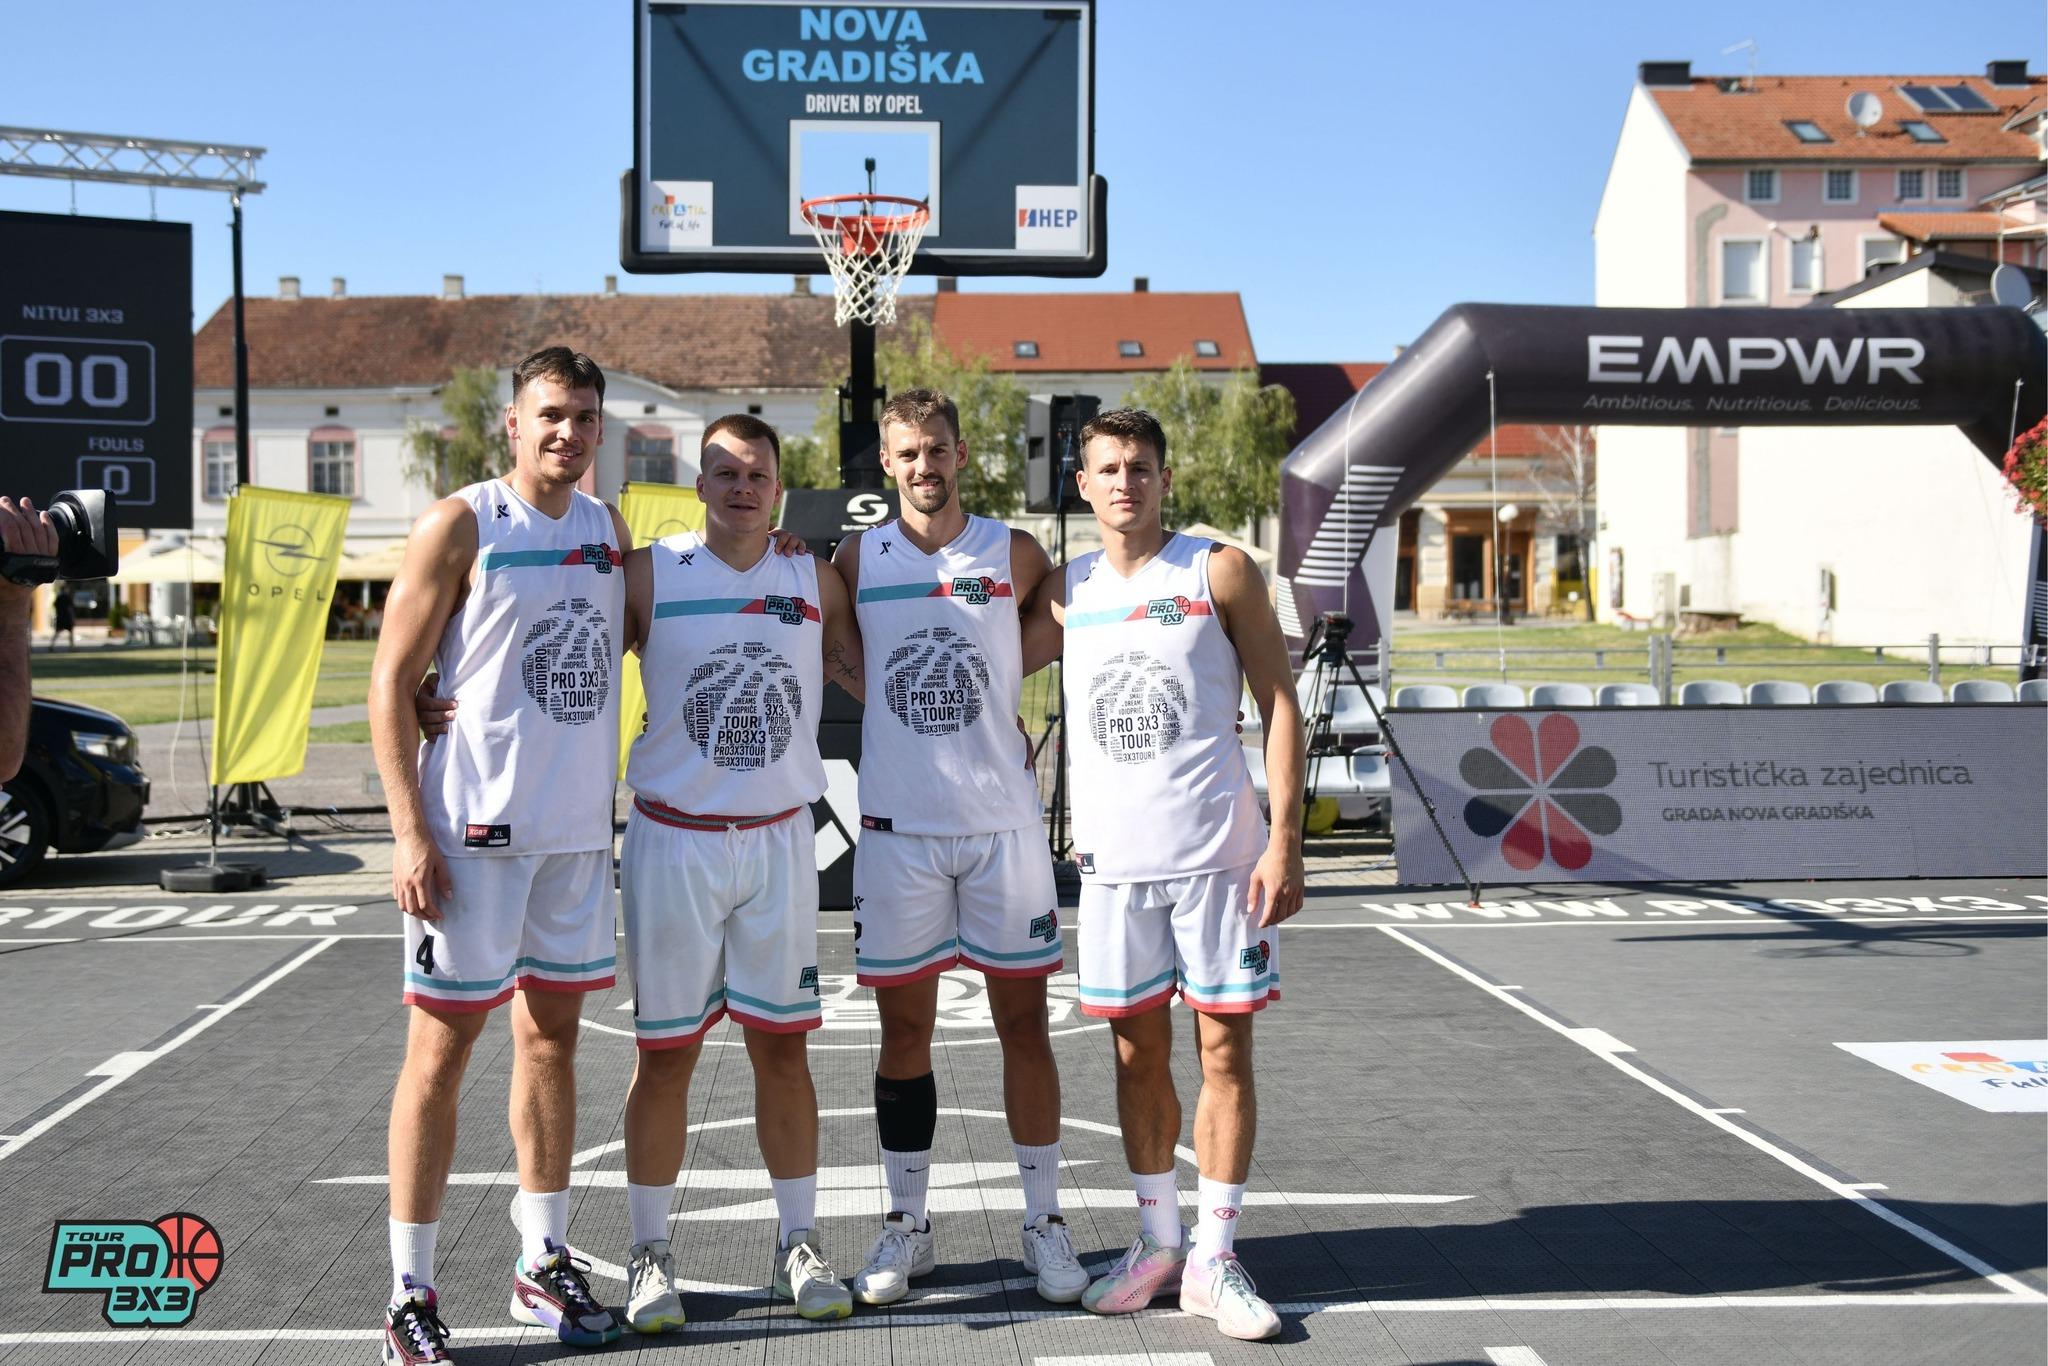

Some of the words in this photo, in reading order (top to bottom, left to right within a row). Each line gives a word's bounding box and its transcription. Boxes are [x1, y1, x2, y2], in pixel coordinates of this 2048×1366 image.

[800, 9, 927, 42] NOVA
[742, 43, 984, 84] GRADIŠKA
[805, 94, 860, 113] DRIVEN
[864, 95, 882, 114] BY
[886, 95, 923, 114] OPEL
[1038, 209, 1077, 228] HEP
[22, 305, 80, 322] NITUI
[85, 307, 124, 324] 3X3
[1587, 335, 1925, 385] EMPWR
[24, 352, 128, 408] 00
[1584, 394, 1694, 411] Ambitious.
[1706, 396, 1813, 412] Nutritious.
[1824, 395, 1921, 412] Delicious.
[89, 437, 144, 452] FOULS
[104, 465, 130, 495] 0
[585, 551, 603, 560] PRO
[248, 583, 326, 601] OPEL
[955, 584, 980, 592] PRO
[768, 602, 792, 611] PRO
[1150, 605, 1174, 614] PRO
[532, 624, 550, 633] TOUR
[892, 650, 908, 658] TOUR
[535, 649, 547, 703] #BUDIPRO
[552, 672, 575, 689] PRO
[580, 671, 598, 688] 3X3
[694, 668, 714, 676] TOUR
[955, 679, 972, 689] 3X3
[561, 691, 593, 708] TOUR
[895, 671, 908, 718] #BUDIPRO
[911, 691, 935, 706] PRO
[940, 690, 964, 705] 3X3
[765, 704, 784, 716] 3X3
[922, 706, 955, 722] TOUR
[1150, 703, 1168, 714] 3X3
[696, 692, 709, 747] #BUDIPRO
[723, 716, 758, 729] TOUR
[1096, 699, 1107, 746] #BUDIPRO
[1110, 717, 1133, 733] PRO
[1138, 715, 1159, 731] 3X3
[718, 730, 766, 744] PRO3X3
[925, 724, 956, 733] 3X3TOUR
[1120, 733, 1151, 750] TOUR
[714, 746, 765, 756] PRO3X3TOUR
[1123, 752, 1151, 762] 3X3TOUR
[725, 757, 760, 767] 3X3TOUR
[1648, 761, 1809, 788] Turistička
[1821, 760, 1974, 794] zajednica
[1662, 807, 1725, 822] GRADA
[1728, 806, 1780, 821] NOVA
[1782, 802, 1874, 820] GRADIŠKA
[416, 934, 434, 975] 4
